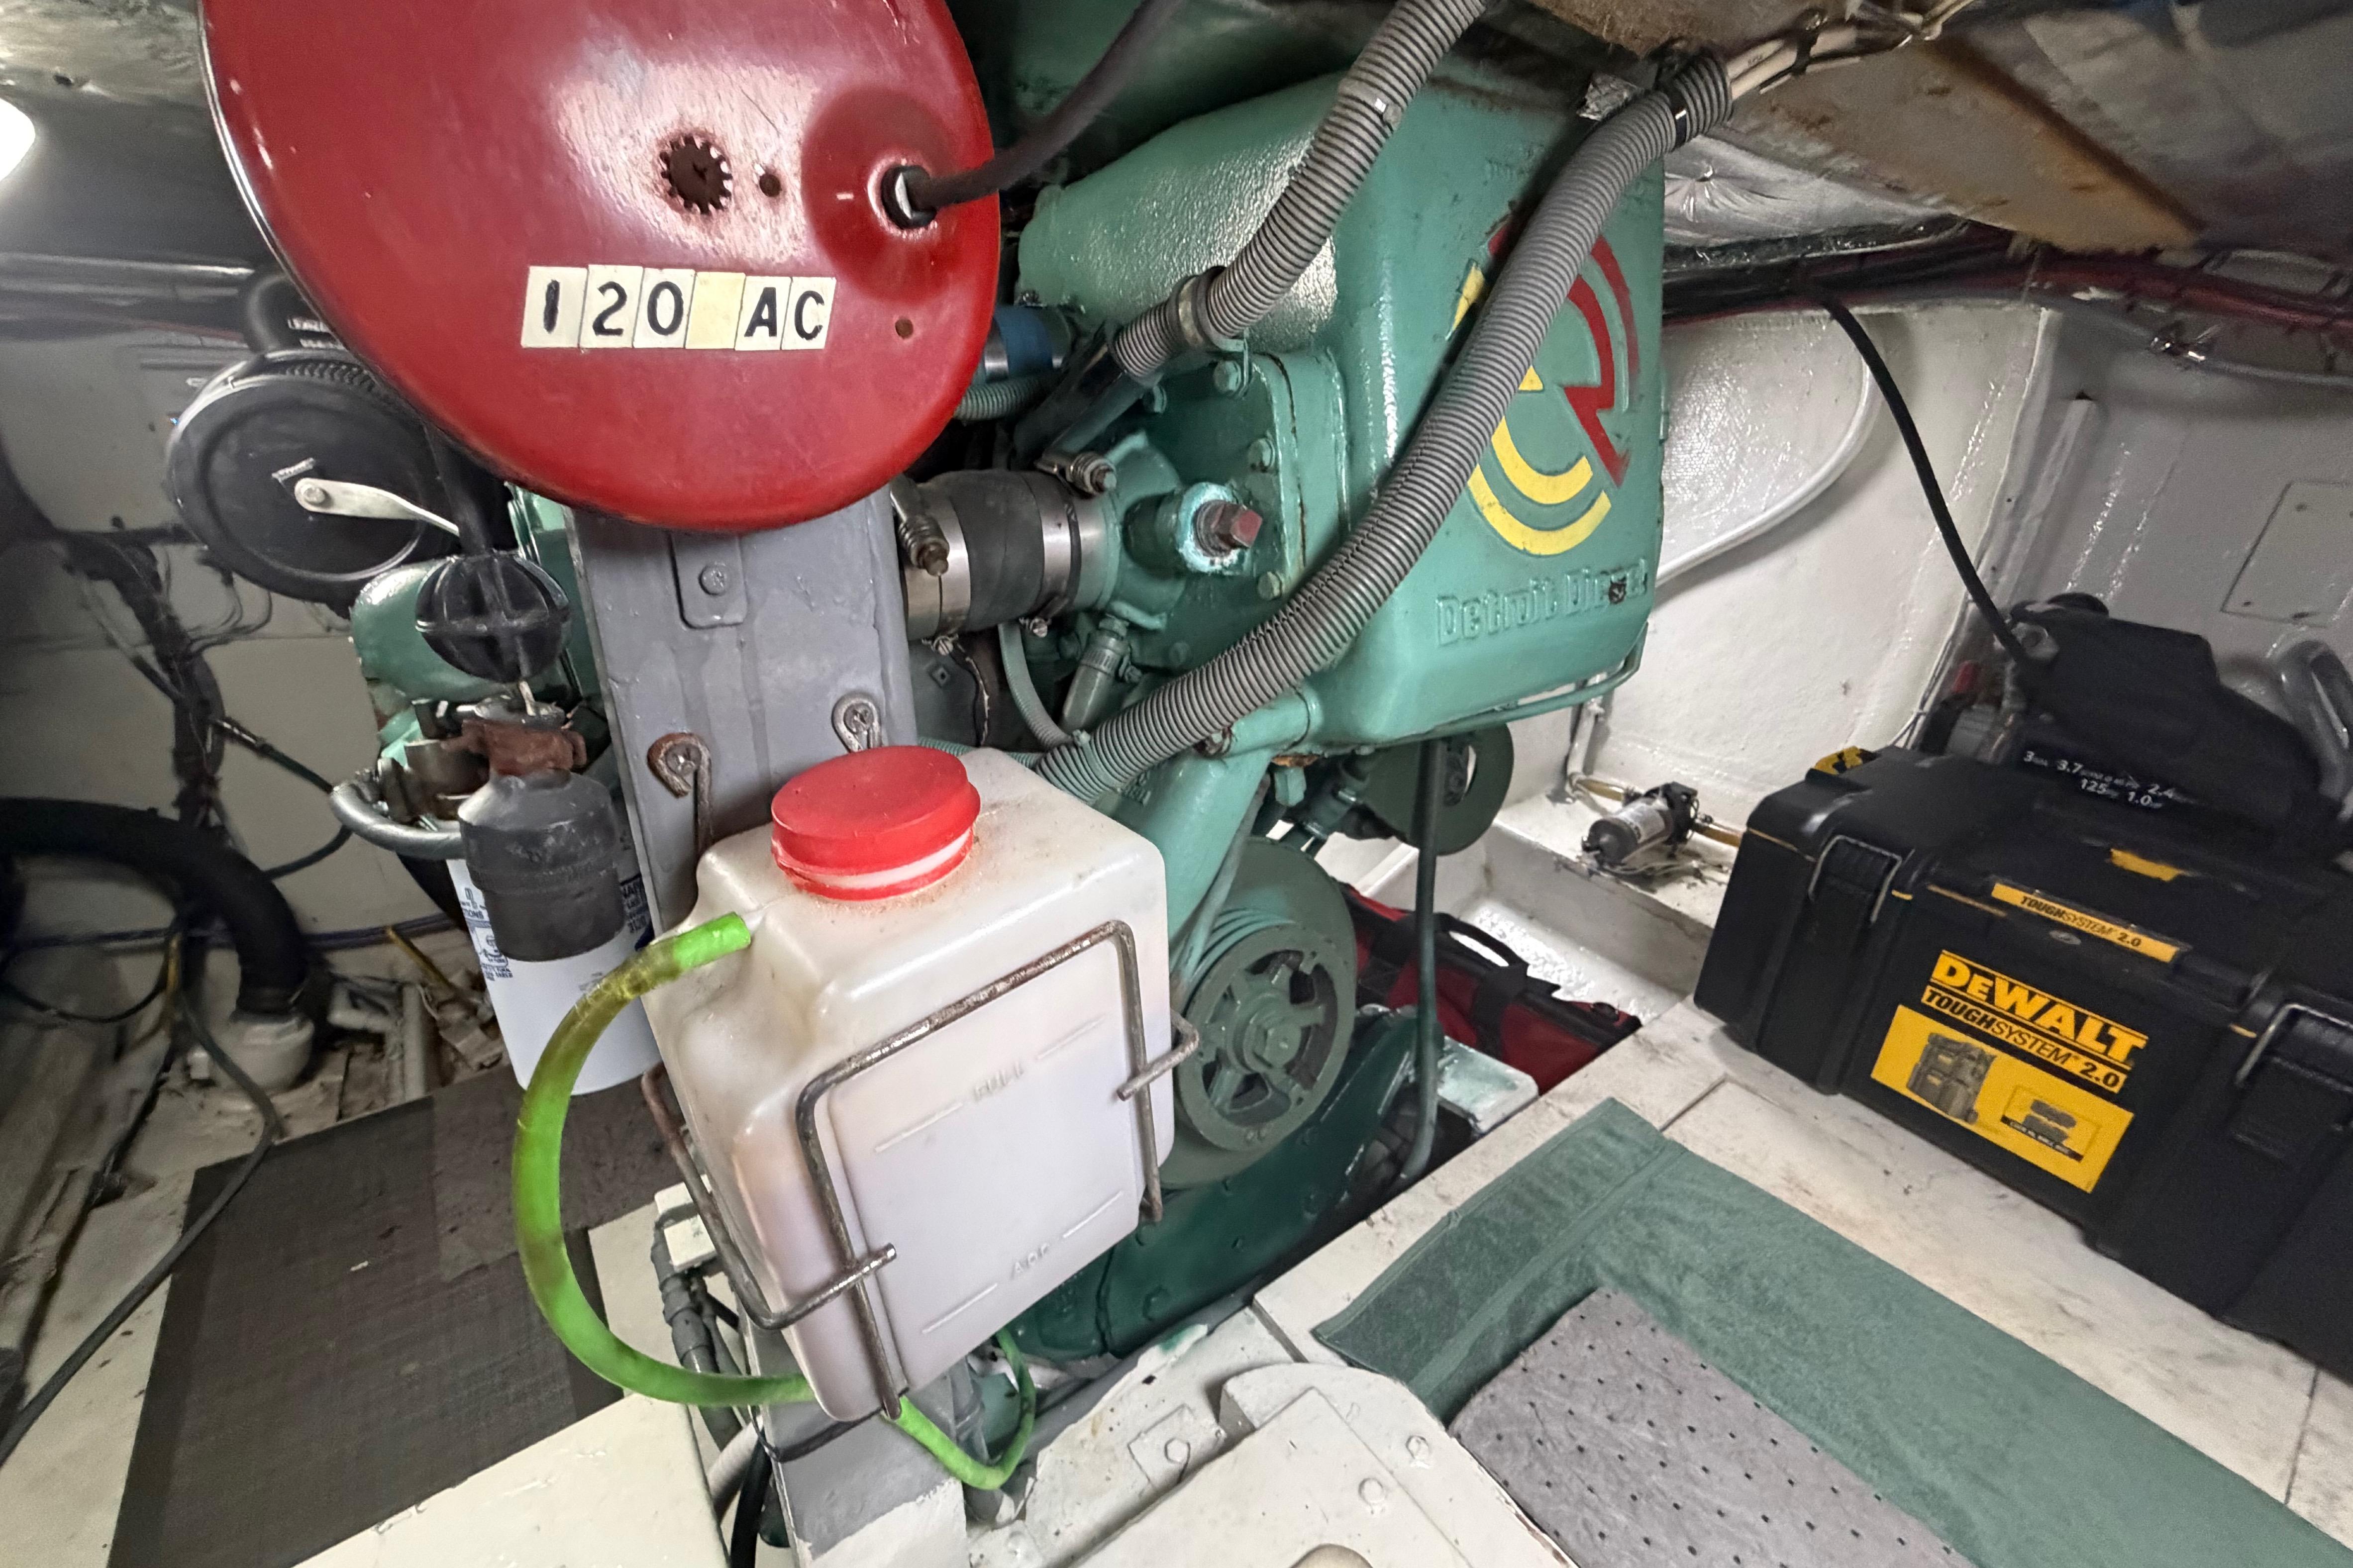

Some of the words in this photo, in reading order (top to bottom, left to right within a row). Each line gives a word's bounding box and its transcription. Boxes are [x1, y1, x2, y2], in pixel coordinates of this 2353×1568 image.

[543, 279, 684, 336] 120
[743, 287, 825, 341] AC
[2020, 896, 2114, 935] TOUGHSYSTEM
[2117, 932, 2142, 947] 2.0
[1925, 988, 2070, 1066] TOUGHSYSTEM
[2081, 1061, 2121, 1090] 2.0
[1931, 953, 2147, 1065] DEWALT
